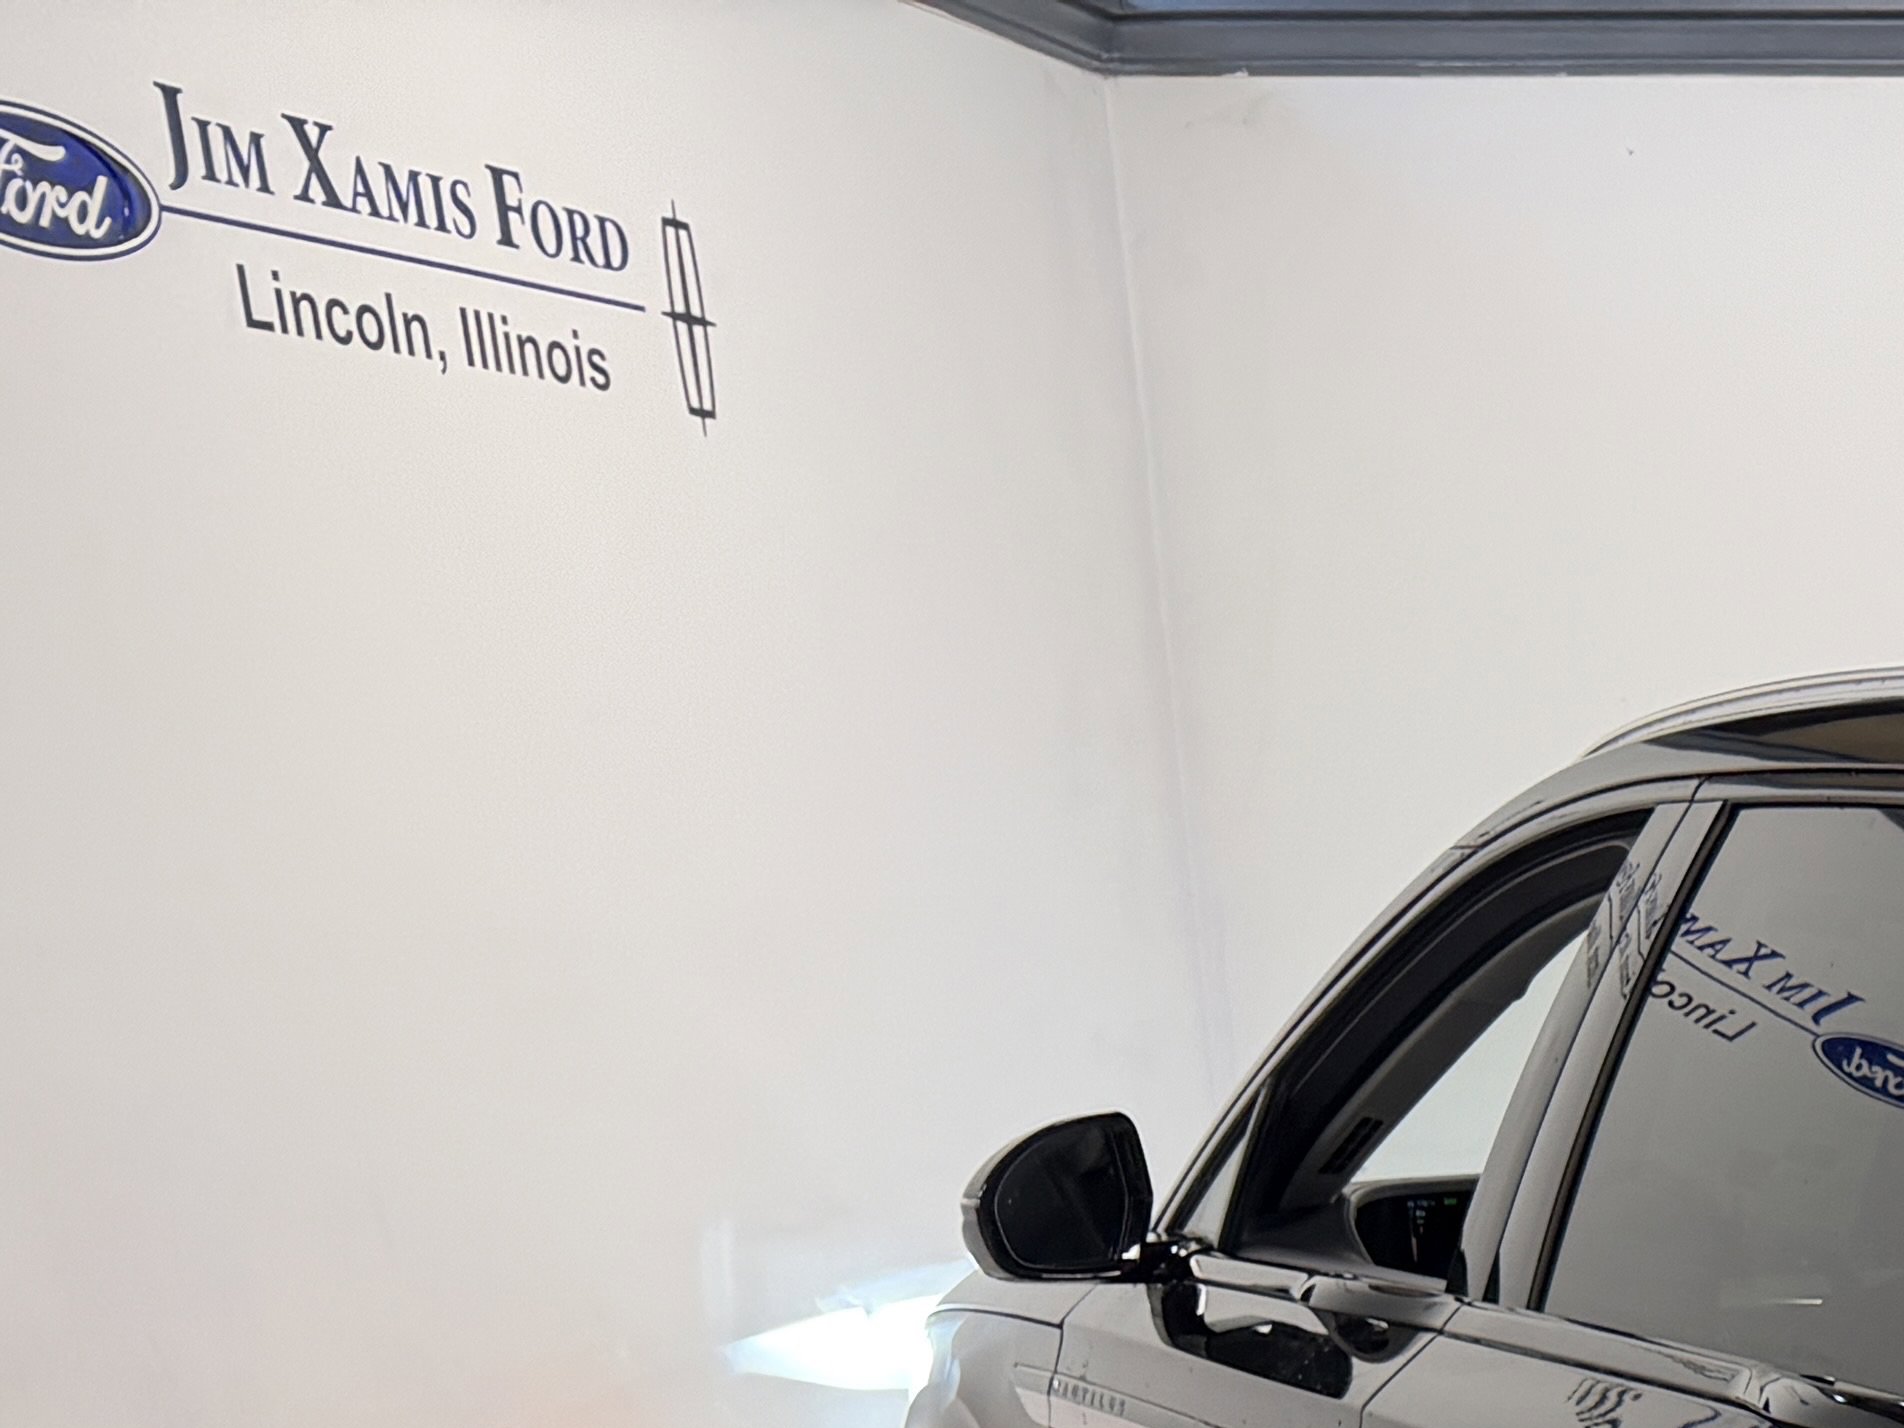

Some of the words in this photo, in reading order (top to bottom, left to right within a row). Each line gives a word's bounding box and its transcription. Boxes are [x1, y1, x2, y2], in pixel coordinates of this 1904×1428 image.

[153, 80, 276, 196] JIM
[280, 112, 477, 240] XAMIS
[485, 163, 630, 272] FORD
[236, 263, 448, 374] Lincoln,
[458, 306, 612, 392] Illinois
